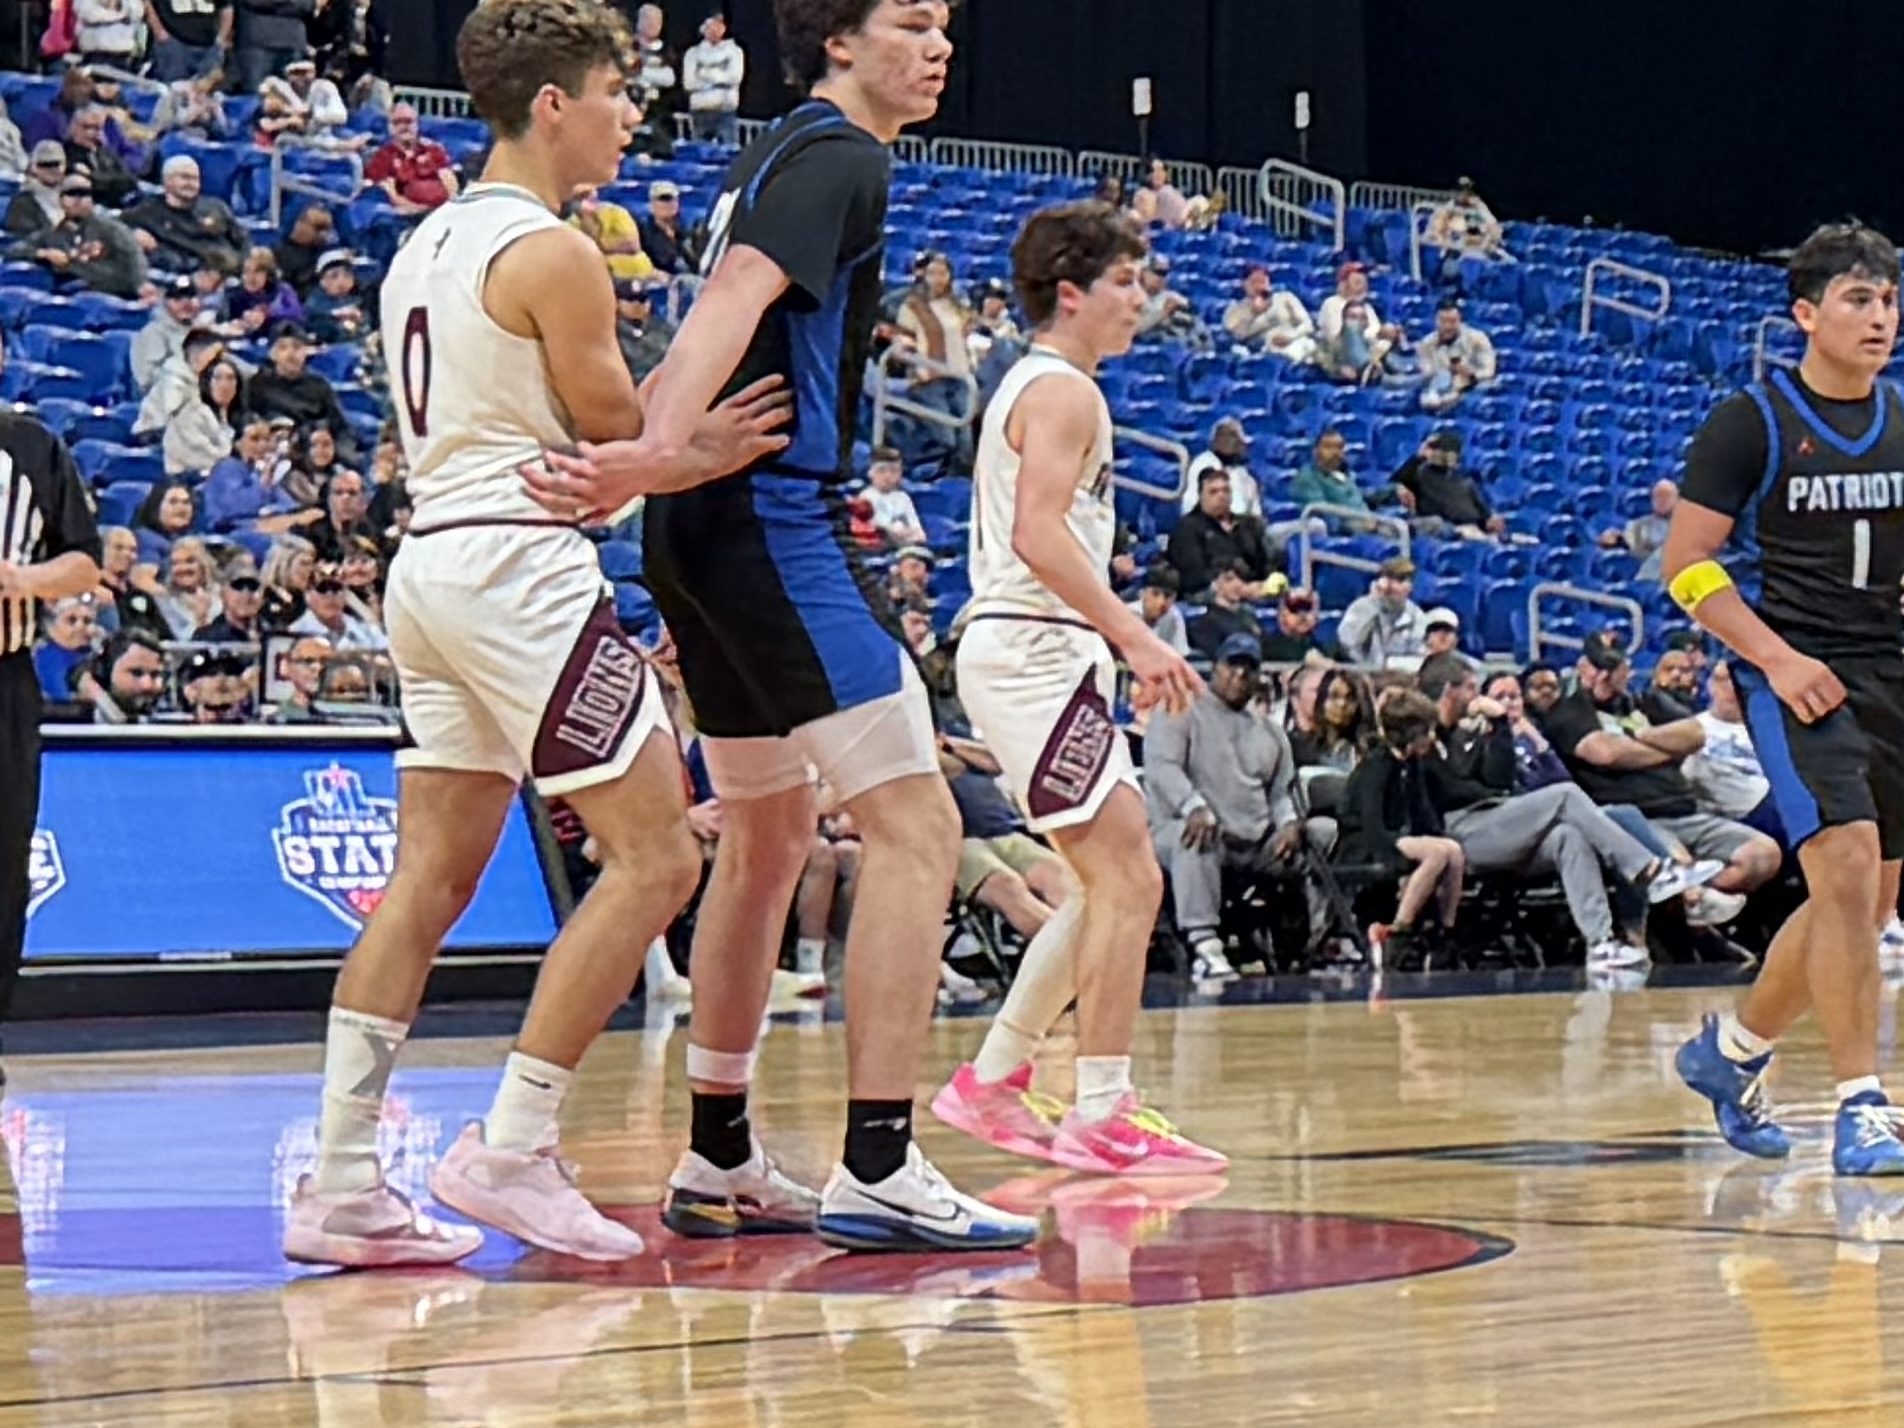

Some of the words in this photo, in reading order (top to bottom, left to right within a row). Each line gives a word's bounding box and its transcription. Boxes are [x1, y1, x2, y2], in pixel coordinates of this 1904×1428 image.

[402, 304, 433, 438] 0
[1852, 518, 1871, 591] 1
[555, 634, 641, 758] LIONS
[282, 834, 398, 876] STAT
